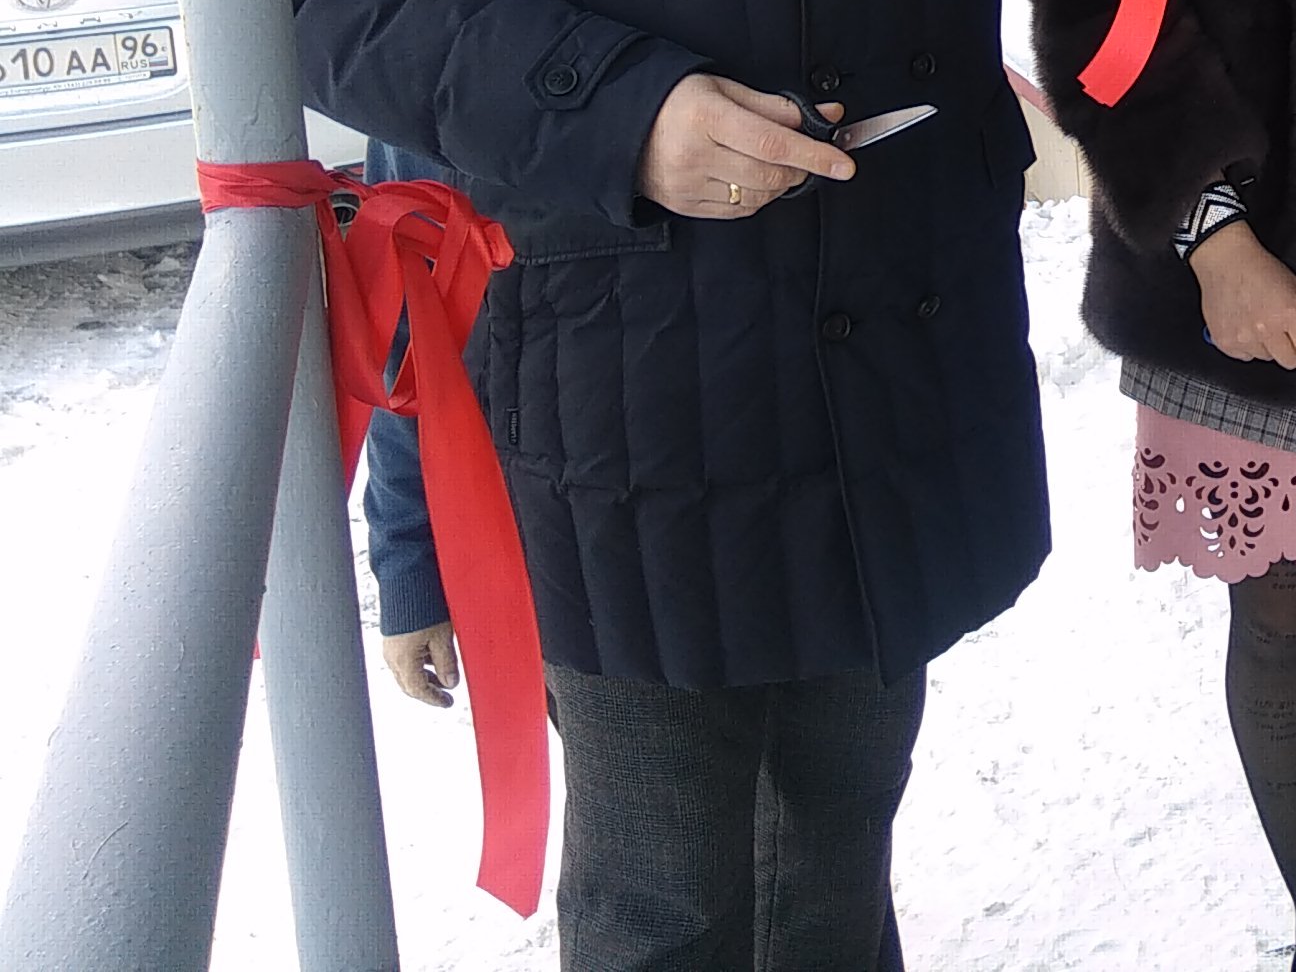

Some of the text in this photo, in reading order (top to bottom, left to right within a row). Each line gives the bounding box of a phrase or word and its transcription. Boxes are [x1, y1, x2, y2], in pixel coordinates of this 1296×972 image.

[0, 47, 55, 81] 10
[121, 33, 159, 60] 96
[121, 59, 148, 71] RUS
